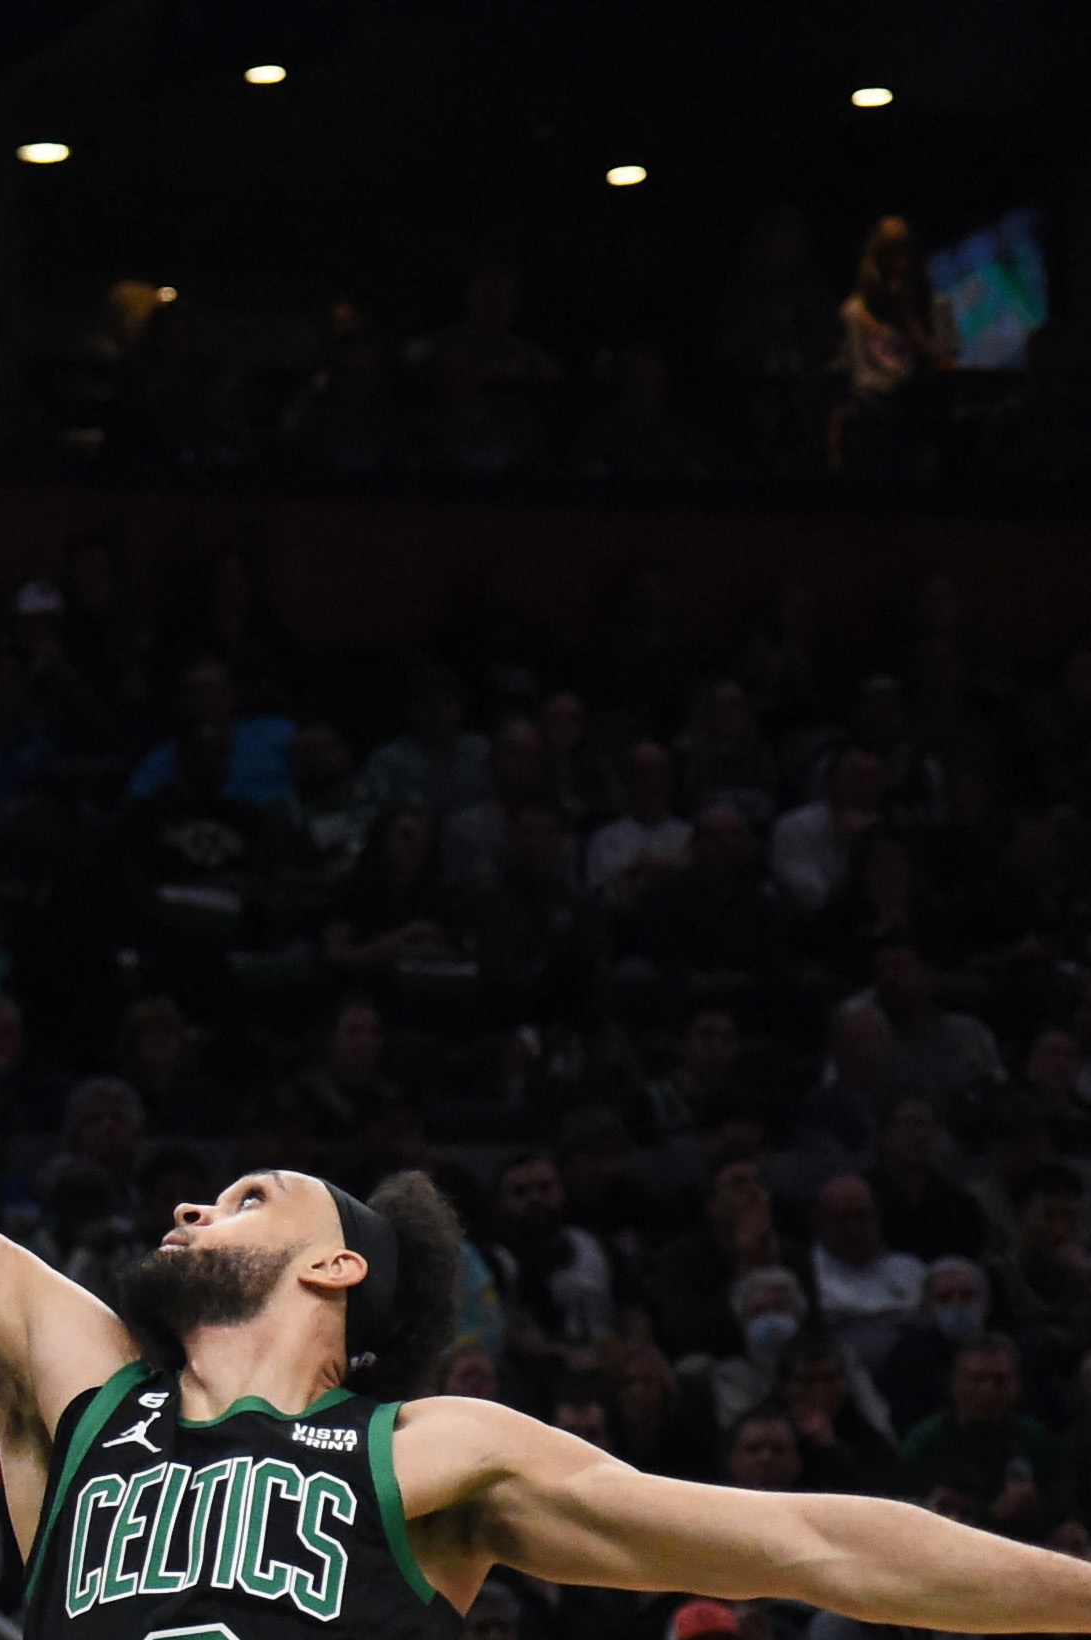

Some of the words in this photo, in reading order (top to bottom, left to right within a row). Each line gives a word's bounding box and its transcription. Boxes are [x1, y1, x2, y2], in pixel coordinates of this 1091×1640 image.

[292, 1430, 357, 1452] PRINT
[294, 1422, 358, 1445] VISTA
[65, 1456, 358, 1622] CELTICS
